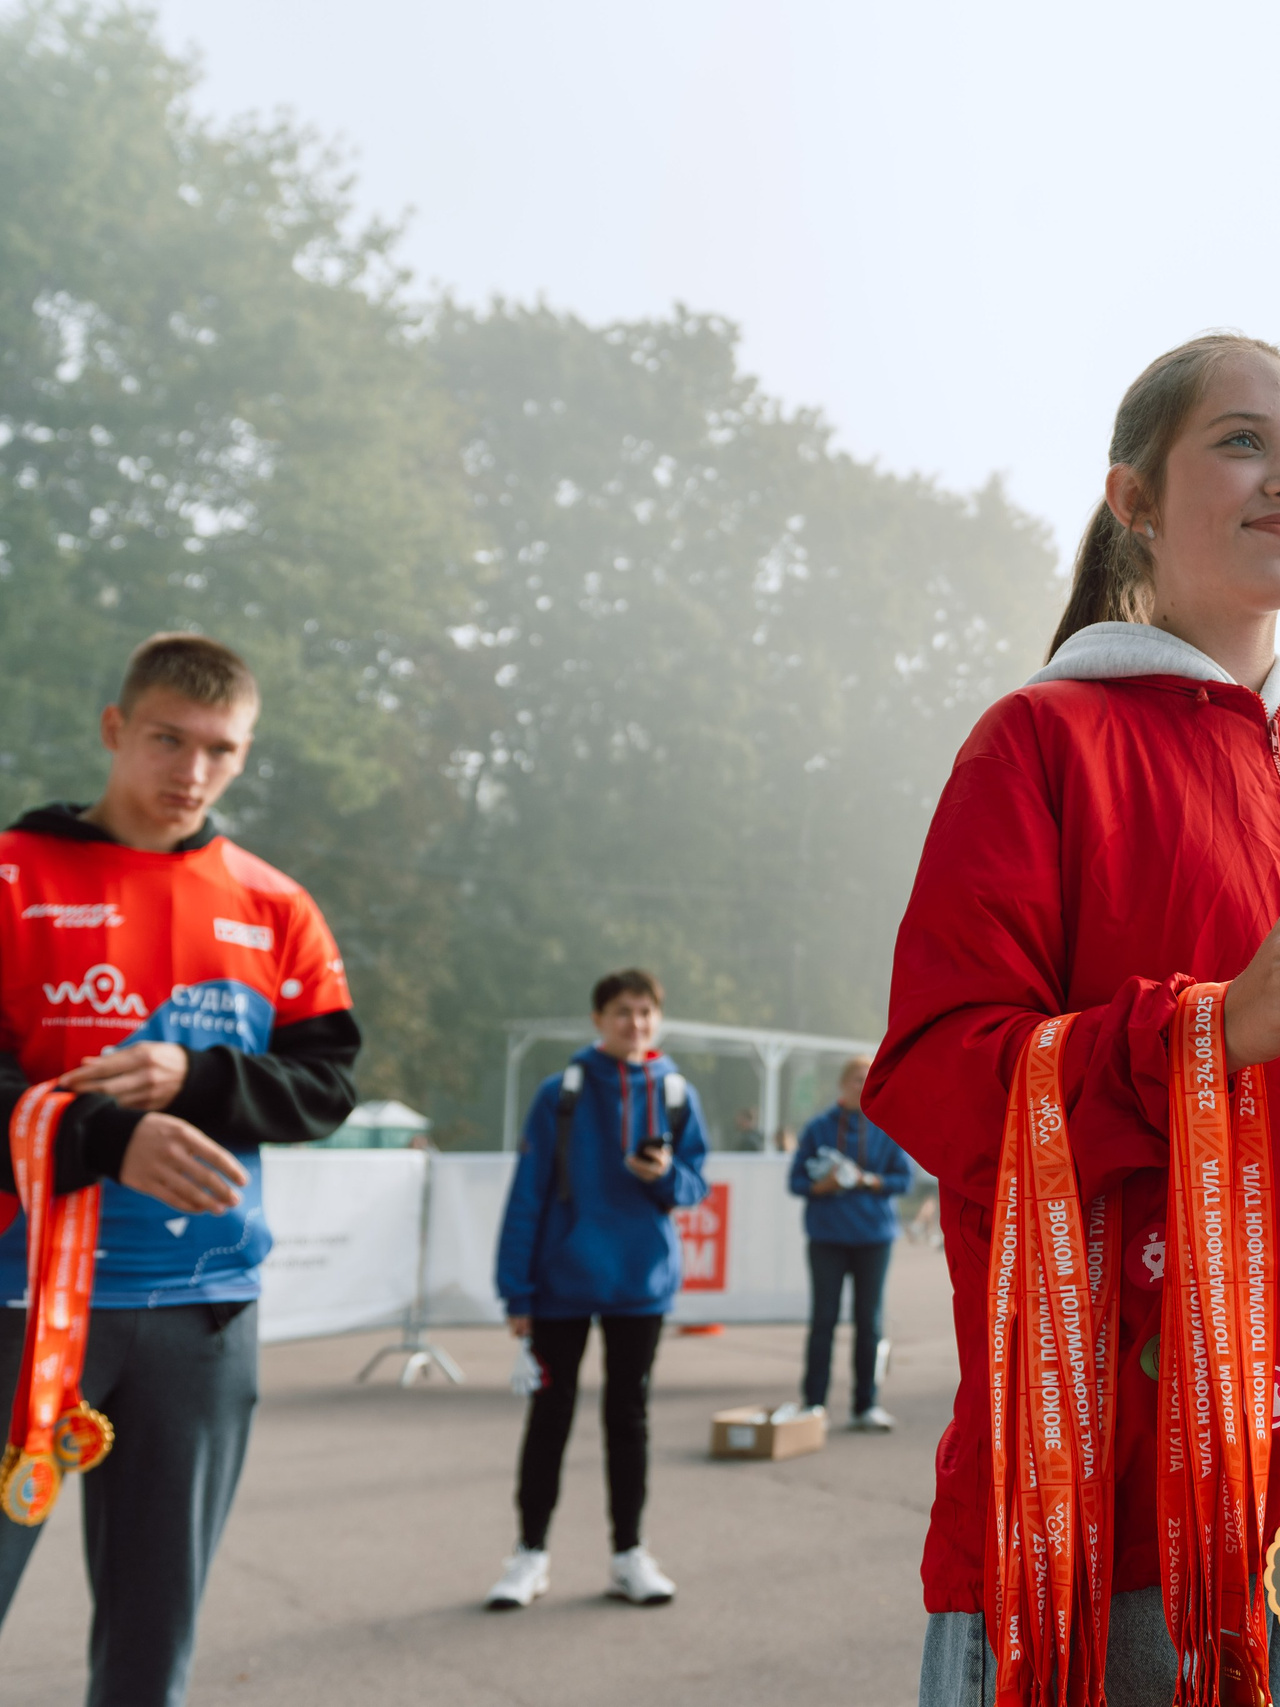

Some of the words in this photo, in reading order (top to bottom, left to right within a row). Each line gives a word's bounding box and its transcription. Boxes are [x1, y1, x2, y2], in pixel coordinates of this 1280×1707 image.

[169, 1011, 250, 1036] referee
[171, 983, 250, 1015] СУДЬЯ
[1047, 1019, 1062, 1027] 5
[1038, 1028, 1057, 1049] КМ
[1195, 996, 1214, 1110] 23-24.08.2025
[1202, 1158, 1221, 1206] ТУЛА
[1242, 1162, 1262, 1208] ТУЛА
[1047, 1200, 1074, 1276] ЭВОКОМ
[1089, 1195, 1105, 1237] ТУЛА
[994, 1224, 1017, 1363] ПОЛУМАРАФОН
[1205, 1210, 1231, 1355] ПОЛУМАРАФОН
[1245, 1212, 1266, 1352] ПОЛУМАРАФОН
[1059, 1285, 1090, 1427] ПОЛУМАРАФОН
[994, 1372, 1003, 1451] ЭВОКОМ
[1041, 1371, 1062, 1450] ЭВОКОМ
[1218, 1364, 1237, 1445] ЭВОКОМ
[1253, 1361, 1266, 1440] ЭВОКОМ
[1081, 1430, 1094, 1479] ТУЛА
[1198, 1429, 1212, 1479] ТУЛА
[1009, 1615, 1019, 1644] КМ
[1058, 1610, 1066, 1639] КМ
[1010, 1649, 1021, 1661] 5
